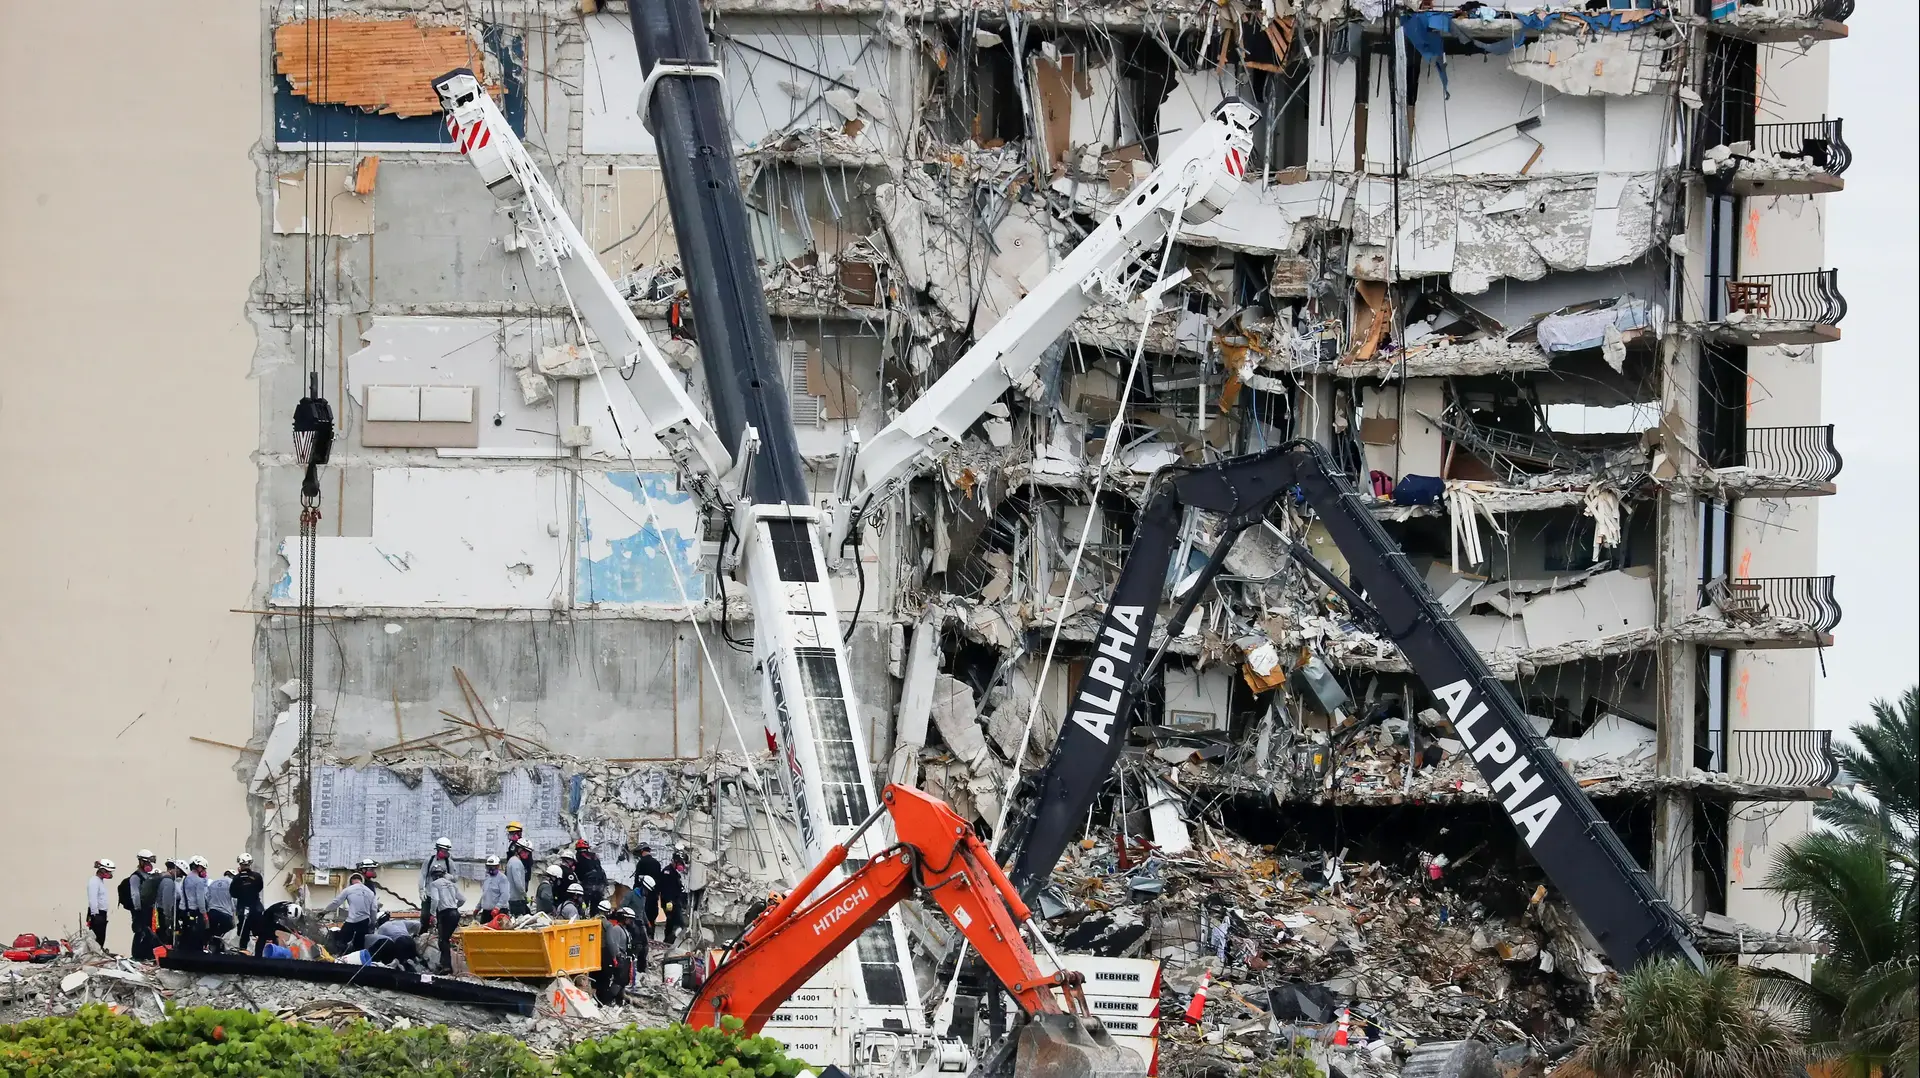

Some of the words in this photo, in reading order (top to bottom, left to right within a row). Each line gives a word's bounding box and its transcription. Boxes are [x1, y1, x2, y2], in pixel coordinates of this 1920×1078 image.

[1072, 606, 1144, 745] ALPHA
[1432, 679, 1562, 848] ALPHA
[320, 773, 333, 826] PROFLEX
[375, 800, 387, 853] PROFLEX
[812, 886, 869, 936] HITACHI
[1095, 972, 1139, 981] LIEBHERR
[1094, 1001, 1138, 1010] LIEBHERR
